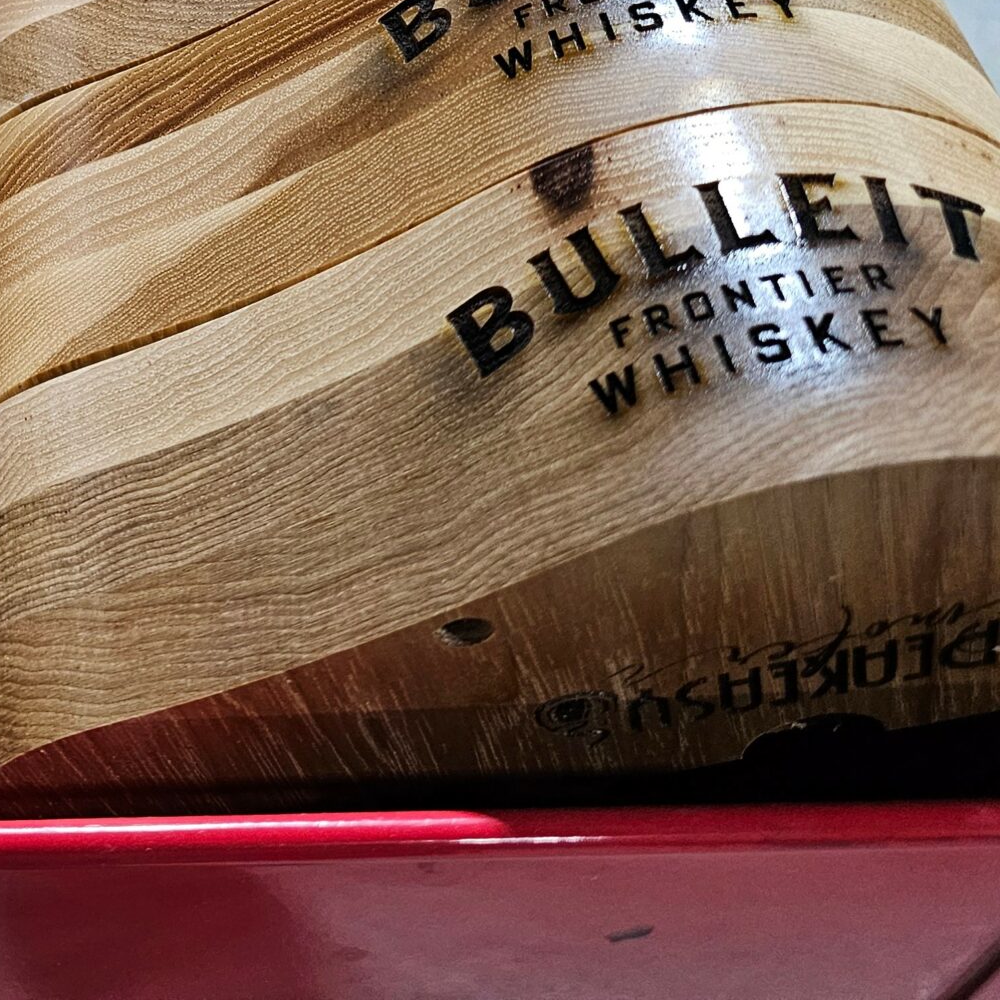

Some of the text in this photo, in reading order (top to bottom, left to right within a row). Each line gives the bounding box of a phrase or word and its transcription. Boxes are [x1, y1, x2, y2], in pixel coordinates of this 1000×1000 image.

[446, 172, 986, 378] BULLEIT
[609, 263, 896, 349] FRONTIER
[588, 306, 949, 417] WHISKEY
[628, 619, 1000, 732] PEAKEASY
